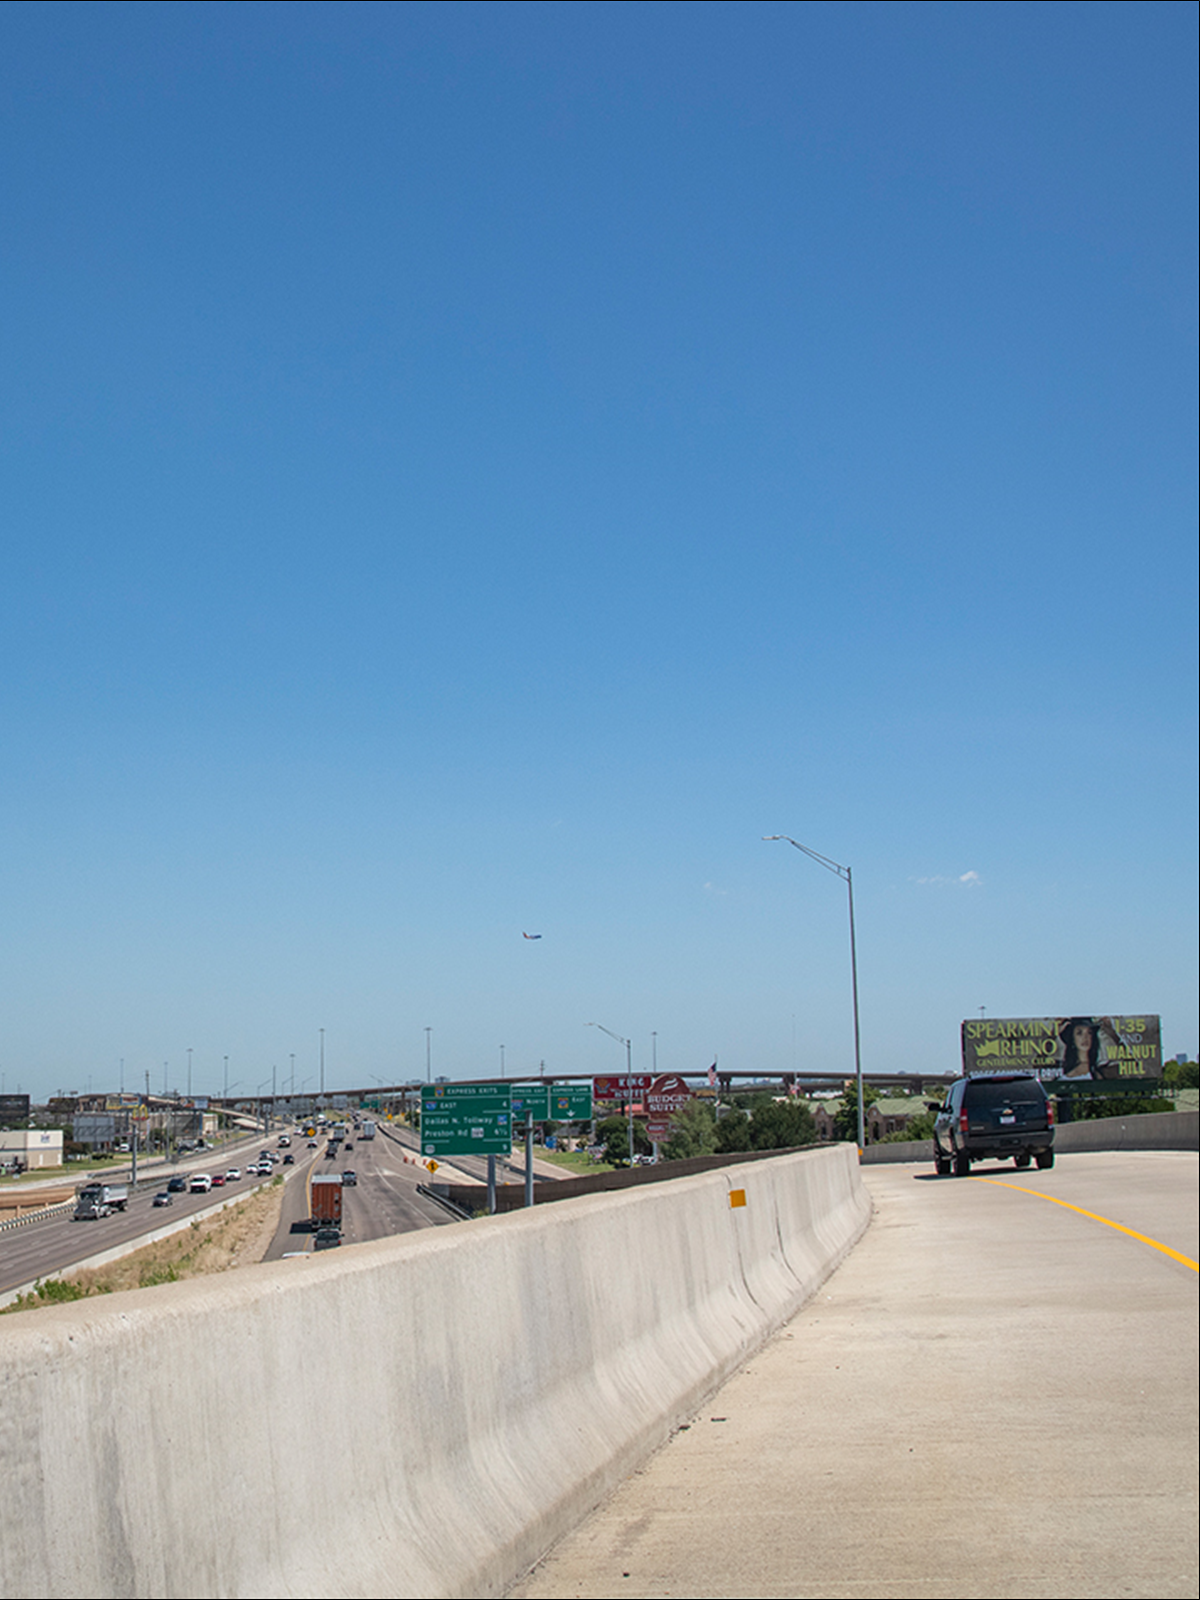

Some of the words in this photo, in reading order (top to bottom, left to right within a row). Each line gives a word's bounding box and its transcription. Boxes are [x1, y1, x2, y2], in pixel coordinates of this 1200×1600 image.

[967, 1021, 1061, 1039] SPEARMINT
[1115, 1018, 1146, 1033] I-35
[1119, 1033, 1143, 1044] AND
[1001, 1038, 1057, 1056] RHINO
[1106, 1044, 1157, 1060] WALNUT
[1118, 1060, 1146, 1076] HILL
[446, 1087, 476, 1095] EXPRESS
[647, 1094, 692, 1103] BUDGET
[424, 1117, 449, 1125] Dallas
[463, 1116, 493, 1126] Tollway
